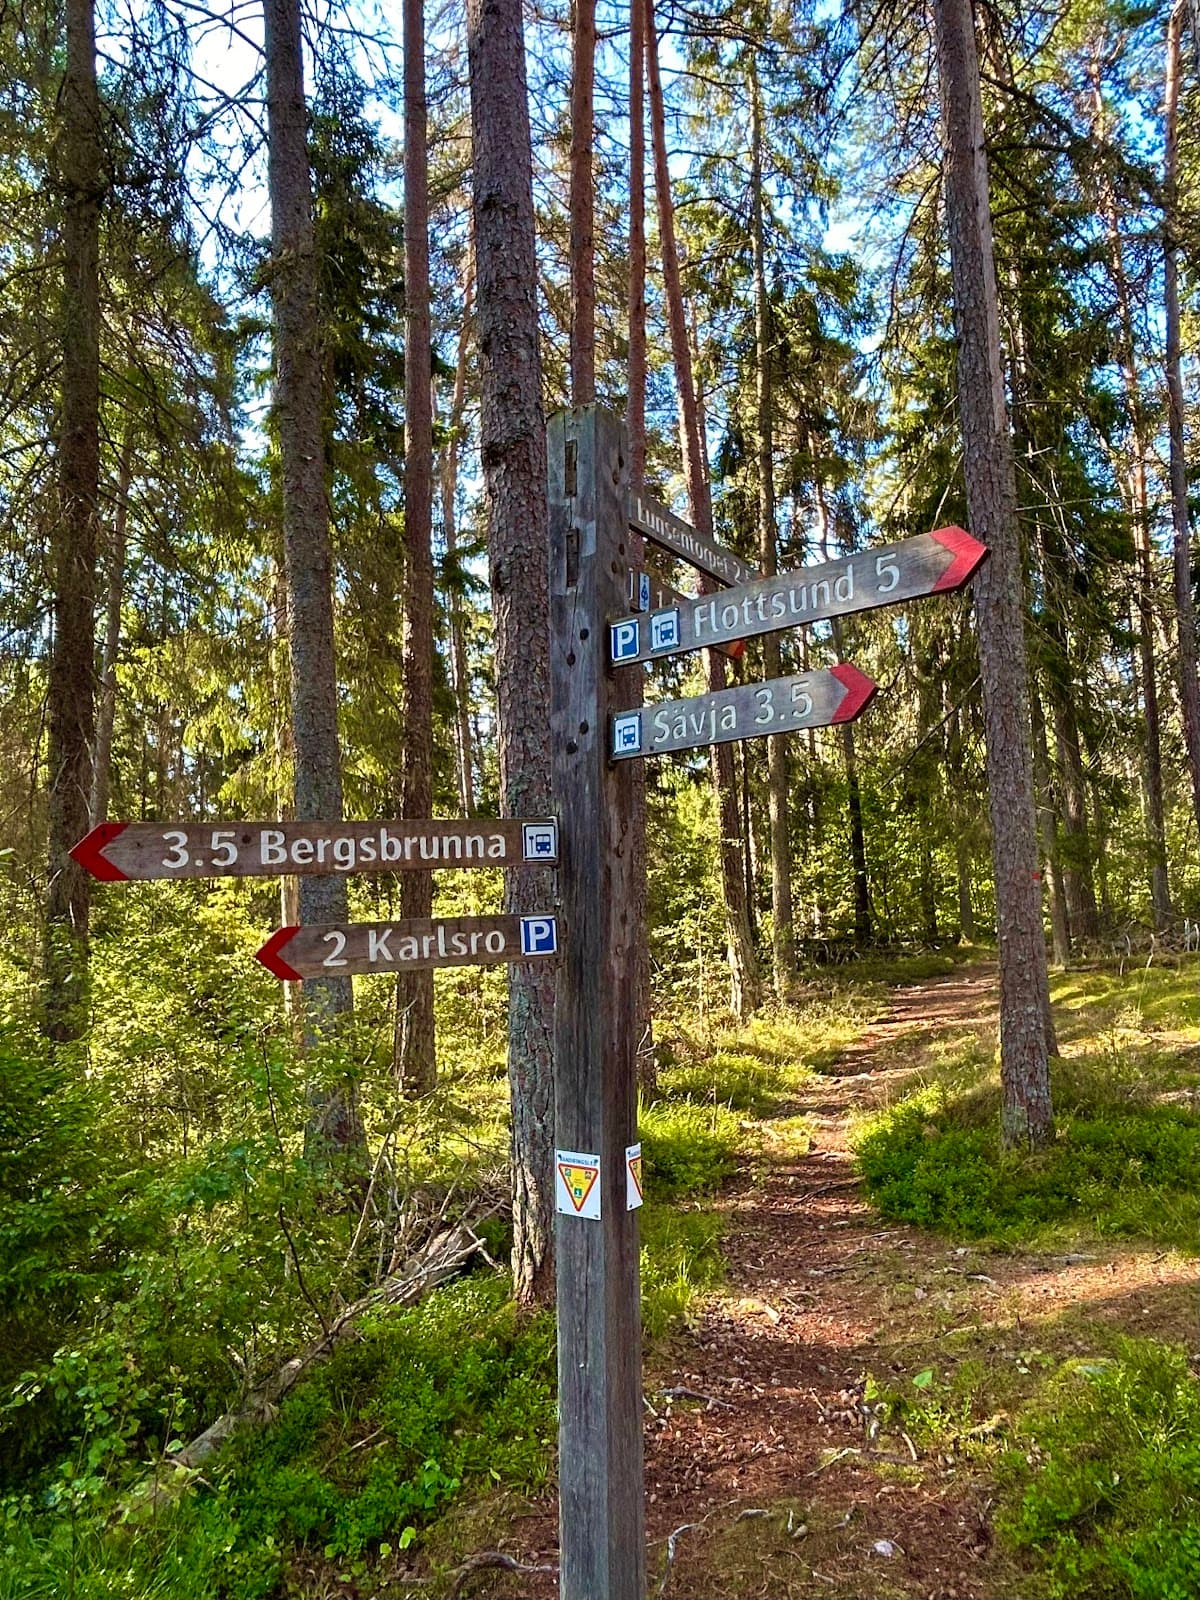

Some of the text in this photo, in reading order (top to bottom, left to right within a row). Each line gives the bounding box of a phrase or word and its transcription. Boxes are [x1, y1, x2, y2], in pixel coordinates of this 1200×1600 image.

[615, 553, 901, 658] P Flottsund 5
[653, 680, 813, 744] Sävja 3.5
[161, 828, 506, 871] 3.5 Bergsbrunna
[322, 921, 552, 967] 2 Karlsro P
